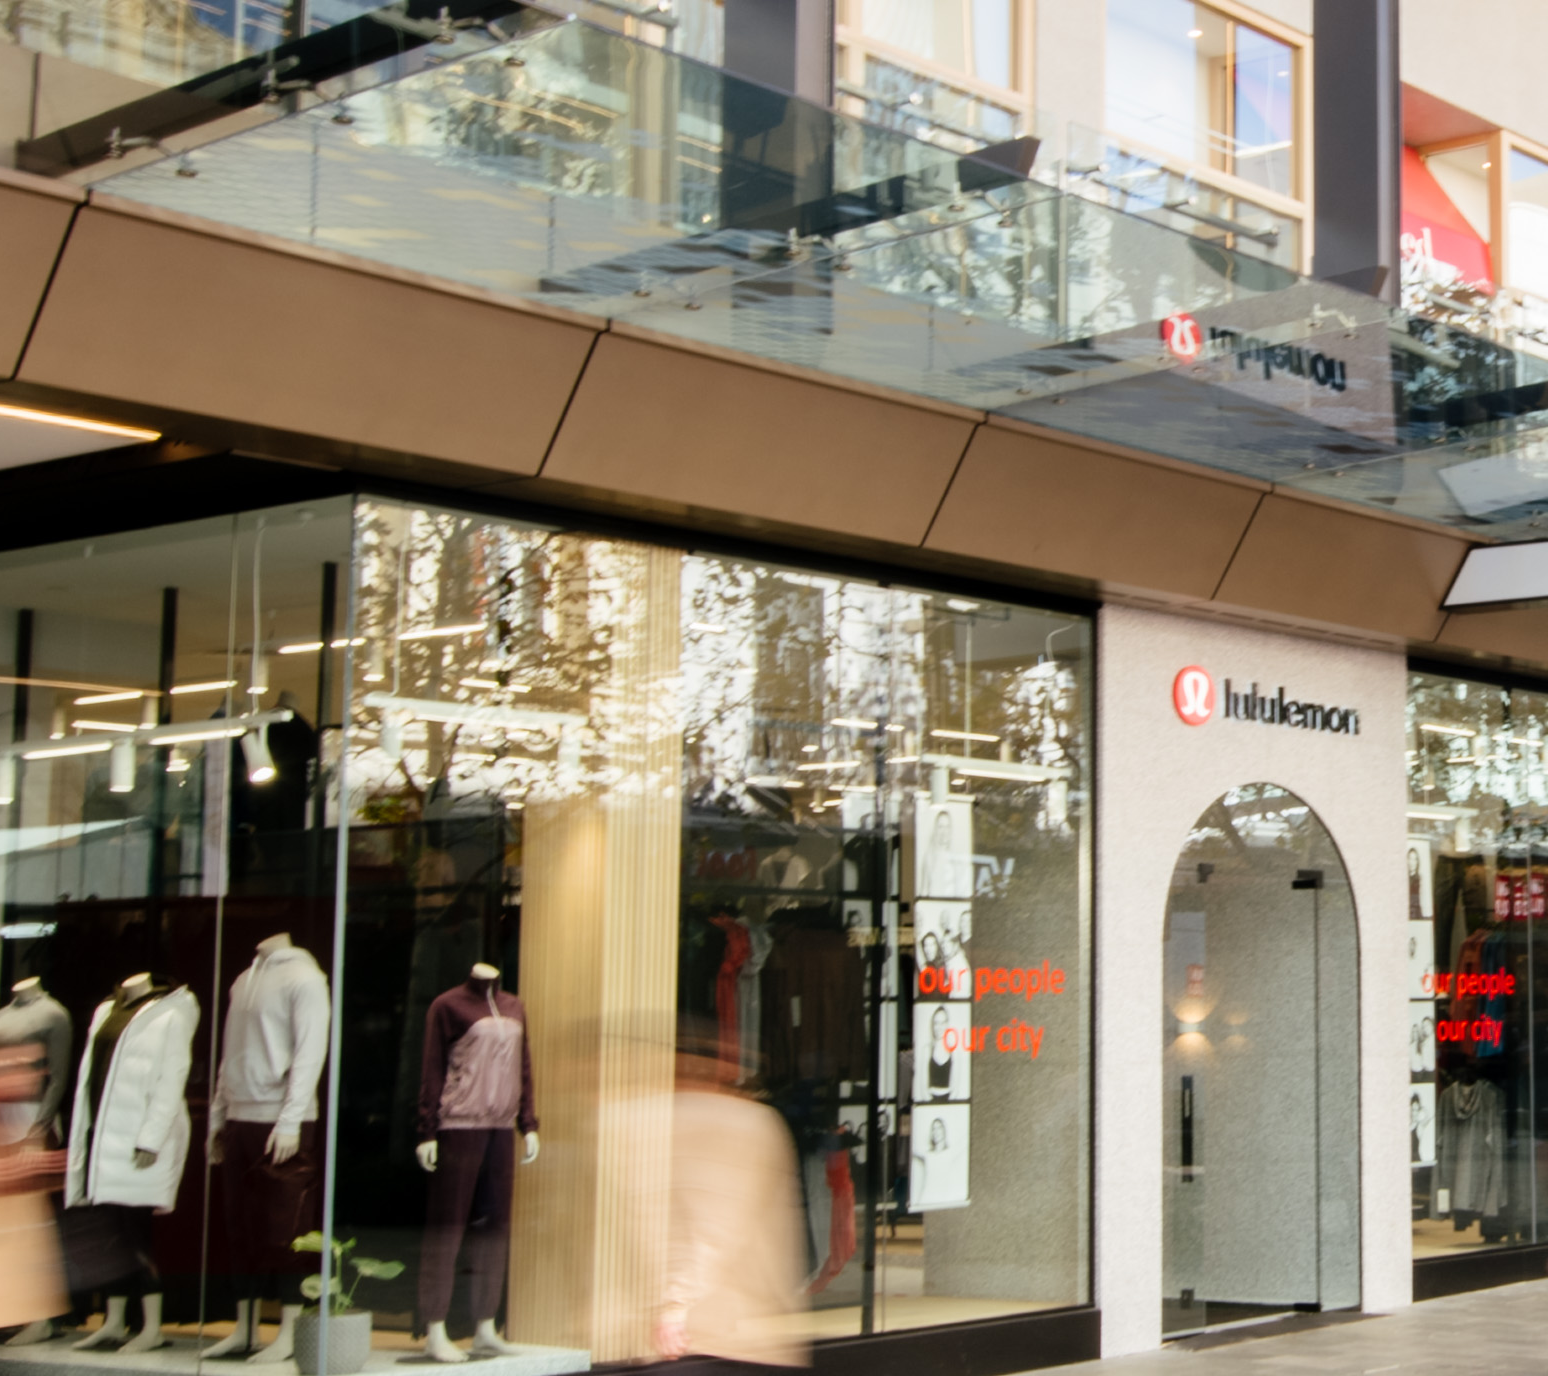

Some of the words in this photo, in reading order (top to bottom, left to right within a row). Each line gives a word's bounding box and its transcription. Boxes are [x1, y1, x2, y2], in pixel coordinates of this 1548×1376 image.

[1221, 678, 1361, 736] lululemon
[919, 964, 967, 994] our
[975, 960, 1065, 1002] people
[1457, 968, 1516, 1000] people
[943, 1025, 991, 1053] our
[997, 1018, 1044, 1059] city
[1436, 1019, 1467, 1042] our
[1471, 1014, 1503, 1047] city
